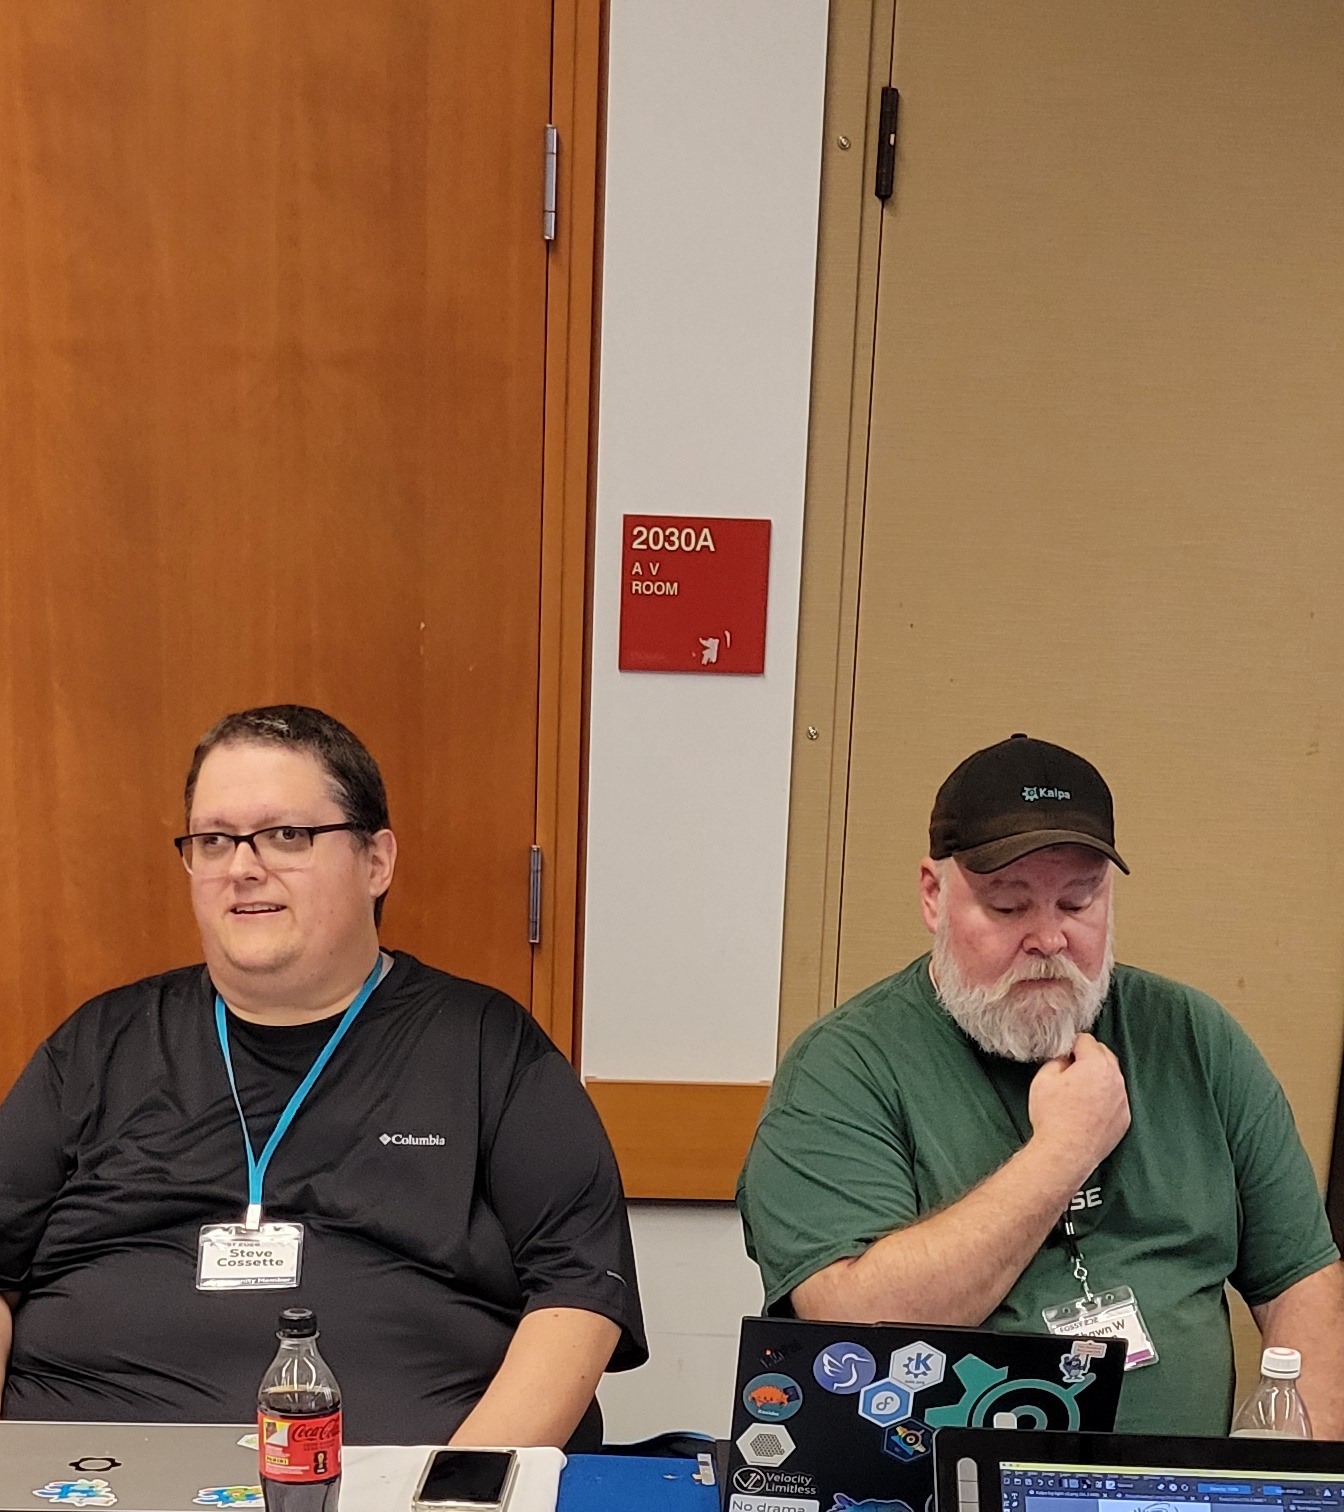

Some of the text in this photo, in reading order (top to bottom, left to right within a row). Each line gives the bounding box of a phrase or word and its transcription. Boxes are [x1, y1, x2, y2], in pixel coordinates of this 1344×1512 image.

[631, 526, 716, 552] 2030A
[631, 561, 660, 576] A V
[631, 581, 679, 596] ROOM
[1039, 787, 1071, 801] Kalpa
[391, 1133, 446, 1146] Columbia
[229, 1248, 273, 1258] Steve
[216, 1257, 284, 1267] Cossette
[1075, 1325, 1113, 1338] hawn
[1112, 1319, 1126, 1331] W
[765, 1472, 813, 1486] Velocity
[765, 1482, 817, 1495] Limitless
[732, 1500, 753, 1512] No
